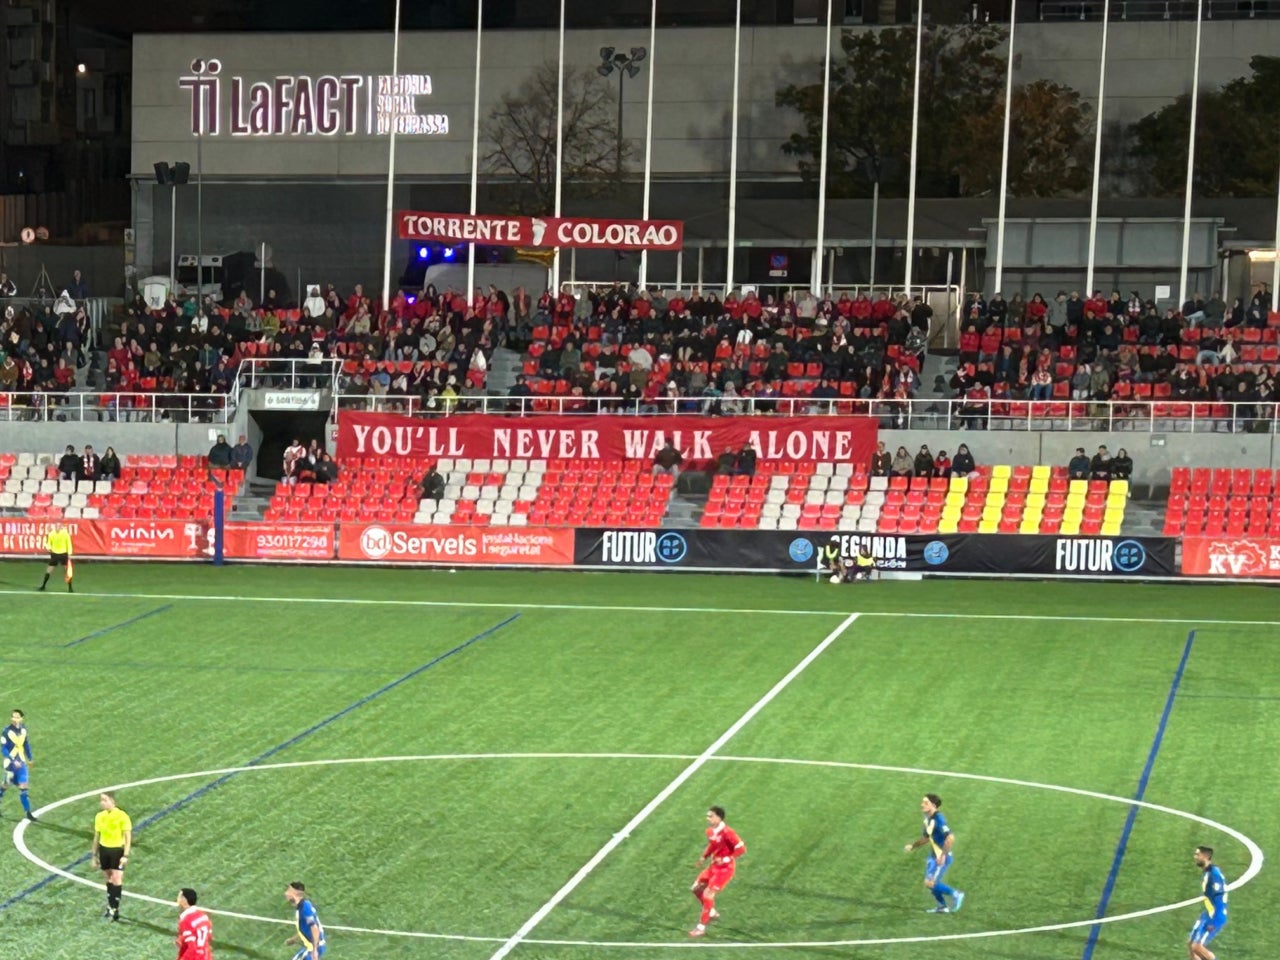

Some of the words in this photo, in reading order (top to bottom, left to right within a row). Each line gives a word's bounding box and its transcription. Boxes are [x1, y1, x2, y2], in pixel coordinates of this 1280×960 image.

[231, 75, 362, 135] LaFACT
[404, 215, 520, 241] TORRENTE
[557, 222, 677, 245] COLORAO
[353, 425, 465, 455] YOU'LL
[493, 429, 600, 458] NEVER
[748, 431, 852, 459] ALONE
[393, 531, 478, 555] Serveis
[602, 531, 657, 563] FUTUR
[1055, 539, 1114, 571] FUTUR
[1208, 554, 1247, 575] KV
